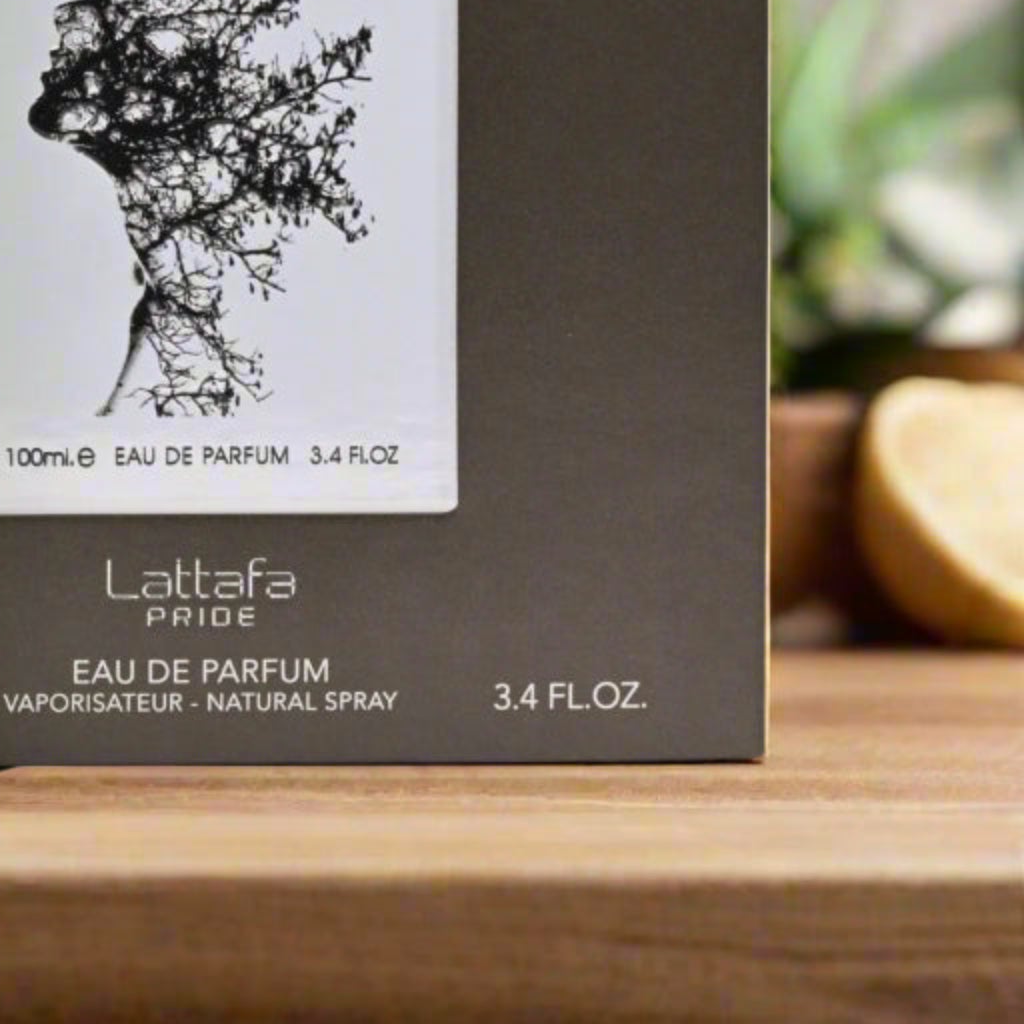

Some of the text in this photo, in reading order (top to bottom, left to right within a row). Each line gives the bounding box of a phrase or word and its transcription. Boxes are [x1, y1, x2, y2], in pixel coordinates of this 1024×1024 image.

[114, 446, 156, 466] EAU
[165, 446, 193, 466] DE
[202, 445, 289, 466] PARFUM
[309, 445, 342, 466] 3.4
[105, 557, 297, 600] Lattafa
[146, 606, 255, 627] PRIDE
[72, 658, 330, 685] EAU DE PARFUM
[3, 692, 183, 713] VAPORISATEUR
[207, 691, 318, 712] NATURAL
[324, 690, 398, 712] SPRAY
[493, 680, 648, 711] 3.4 FL.OZ.
